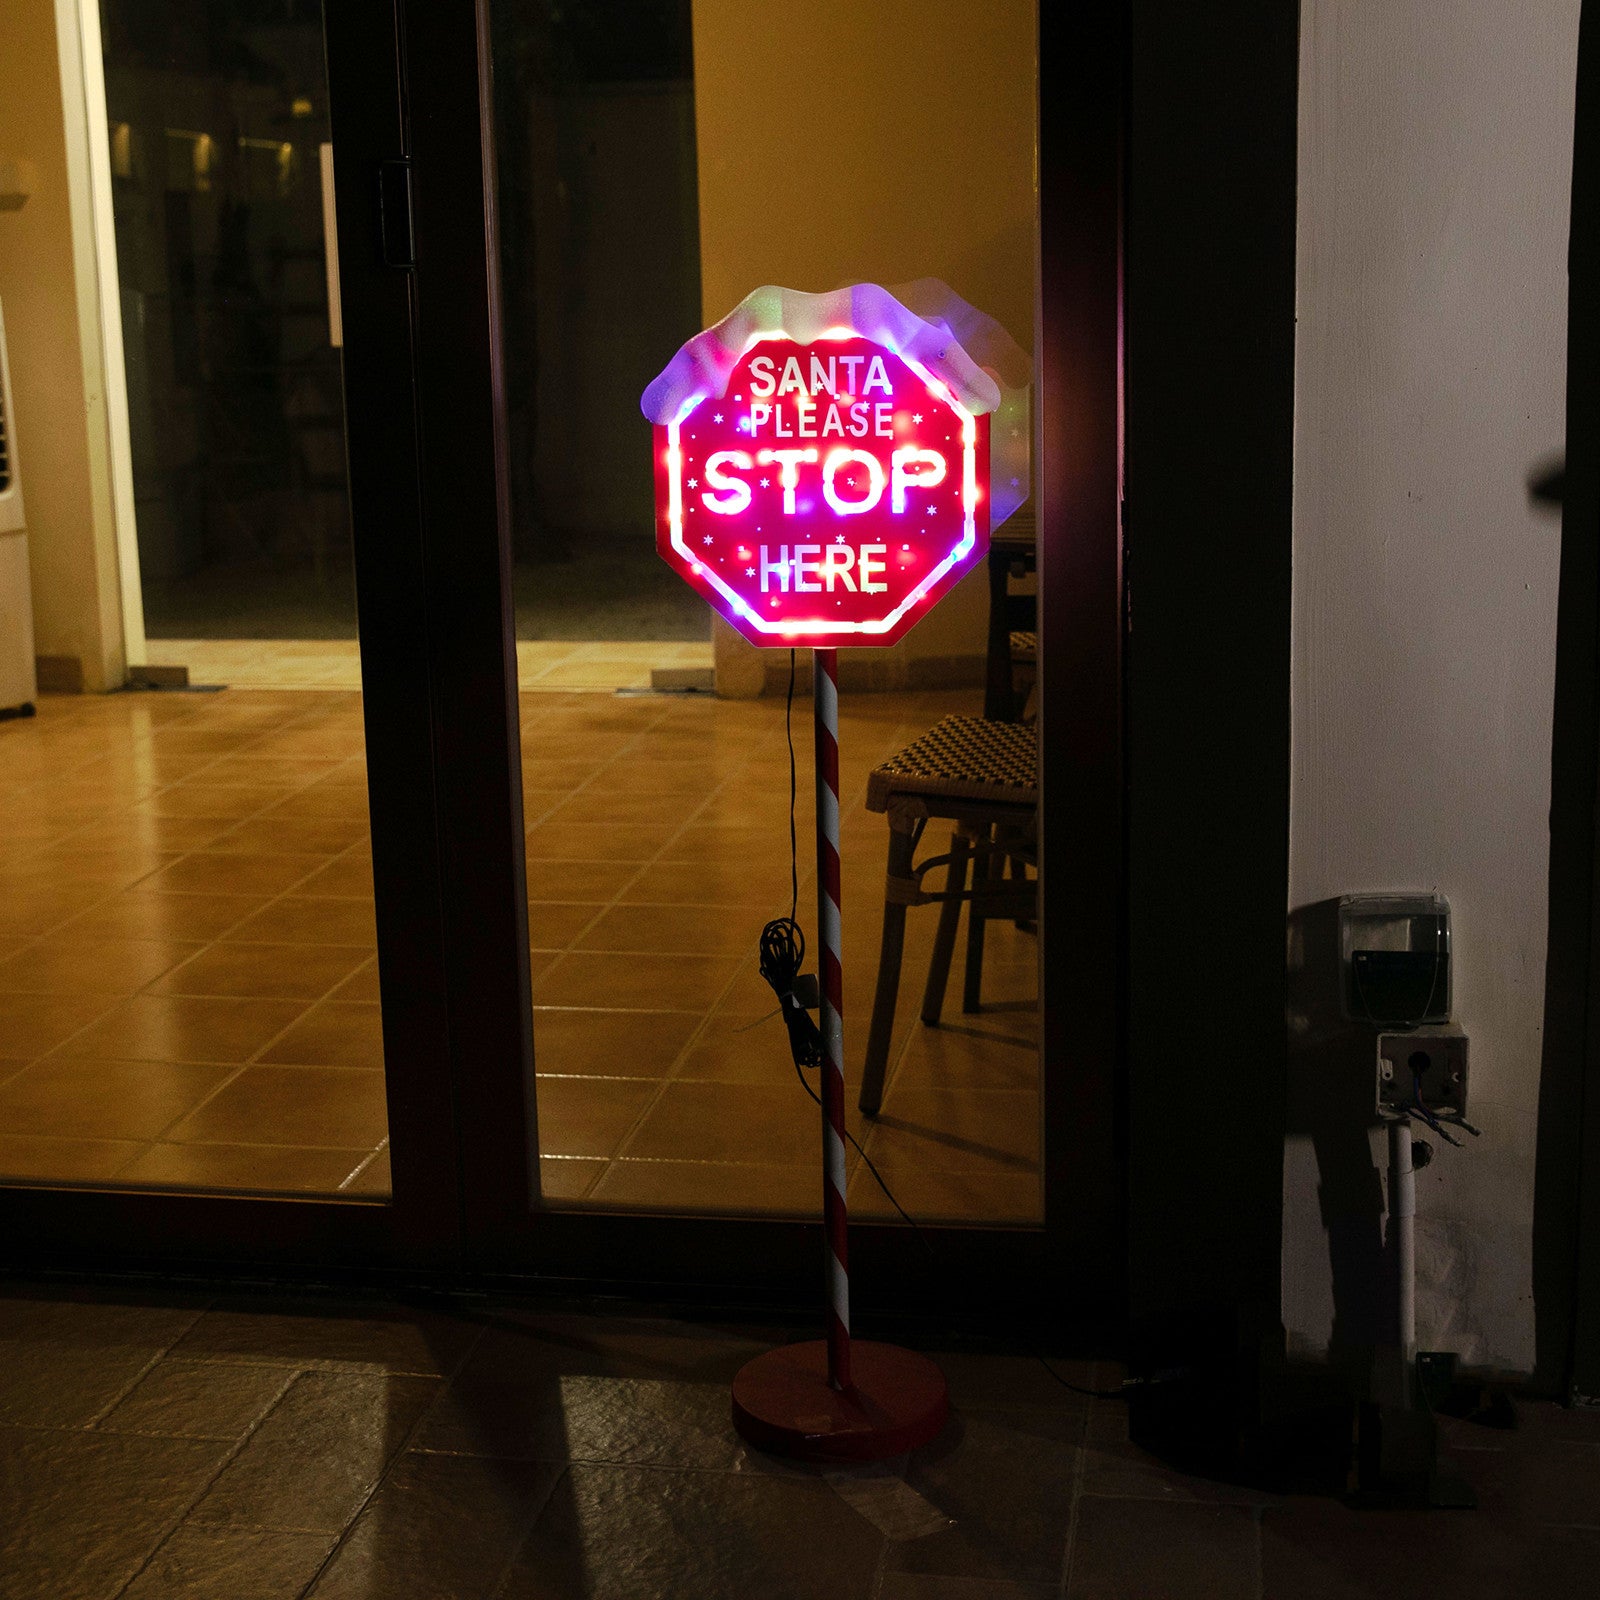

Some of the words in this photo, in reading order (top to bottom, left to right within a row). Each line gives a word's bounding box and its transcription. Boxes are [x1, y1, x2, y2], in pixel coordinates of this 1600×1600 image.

[749, 355, 893, 397] SANTA
[751, 402, 893, 437] PLEASE
[701, 449, 946, 515] STOP
[760, 544, 888, 593] HERE
